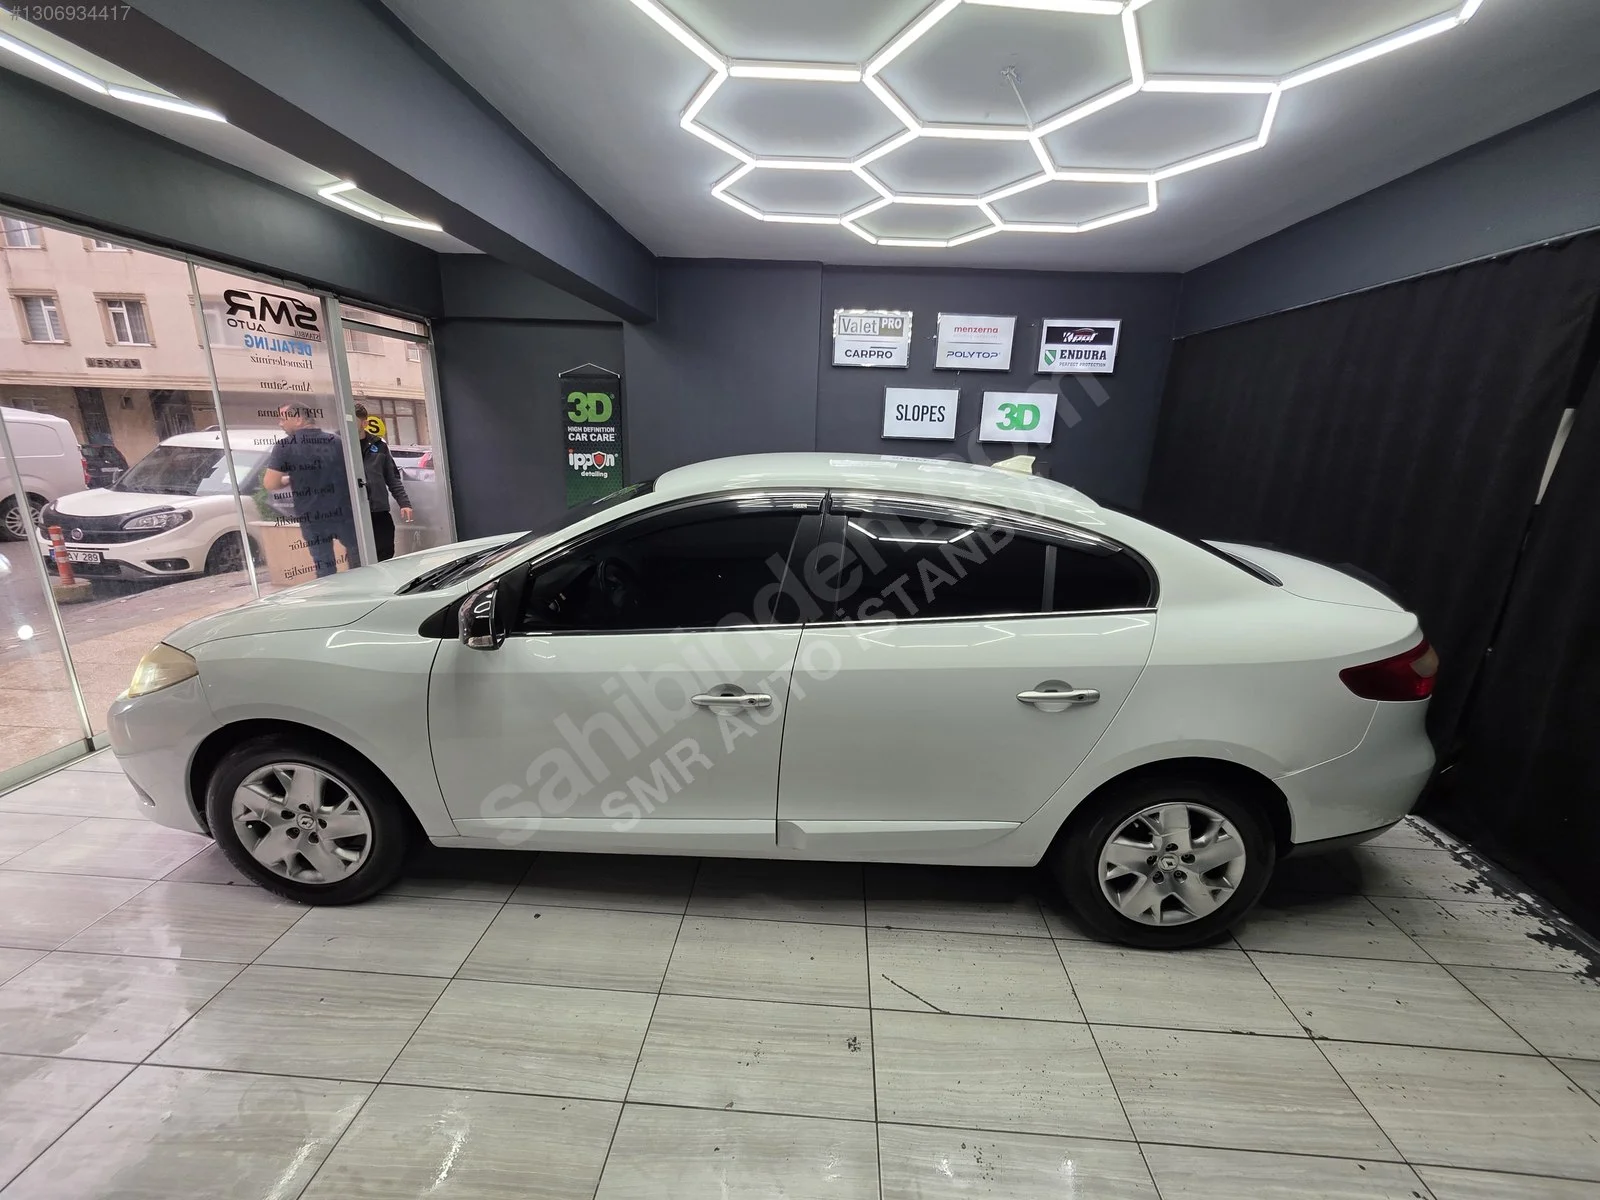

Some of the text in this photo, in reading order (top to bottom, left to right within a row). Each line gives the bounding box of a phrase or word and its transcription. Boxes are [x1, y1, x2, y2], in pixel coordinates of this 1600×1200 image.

[842, 317, 902, 333] Valet PRO
[954, 326, 999, 334] menzerna
[845, 349, 893, 359] CARPRO
[946, 350, 999, 359] POLYTOP
[1059, 349, 1107, 360] ENDURA
[567, 391, 613, 423] 3D
[895, 403, 945, 423] SLOPES
[995, 402, 1041, 431] 3D
[568, 433, 615, 442] CAR CARE
[580, 470, 608, 479] detailing
[83, 552, 98, 562] 289
